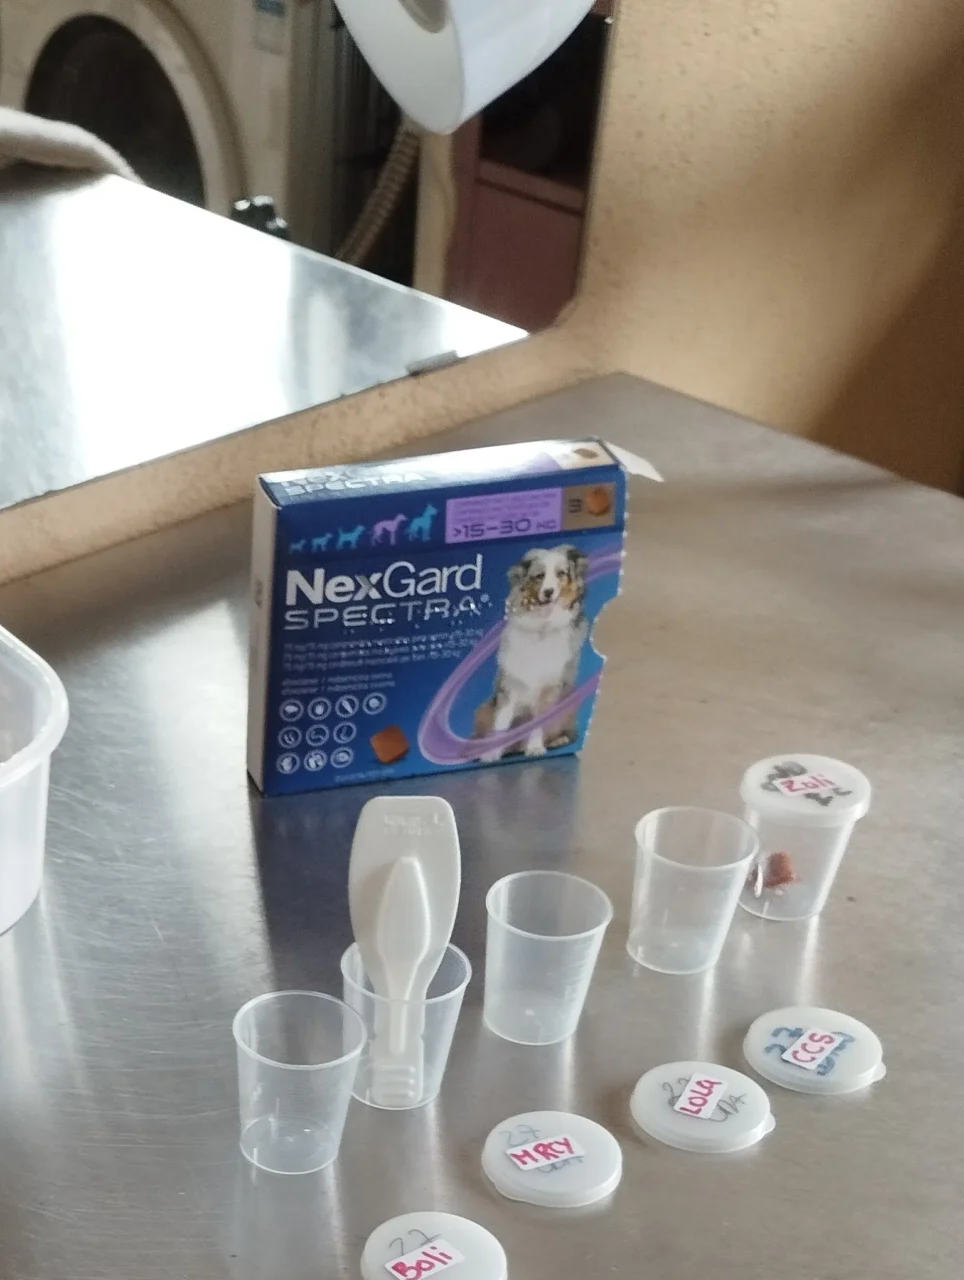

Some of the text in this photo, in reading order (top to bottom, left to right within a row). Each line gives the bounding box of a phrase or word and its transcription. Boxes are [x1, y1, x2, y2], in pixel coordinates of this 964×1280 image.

[286, 553, 483, 606] NexGard
[792, 1033, 836, 1063] CCS
[391, 1246, 453, 1280] Boli
